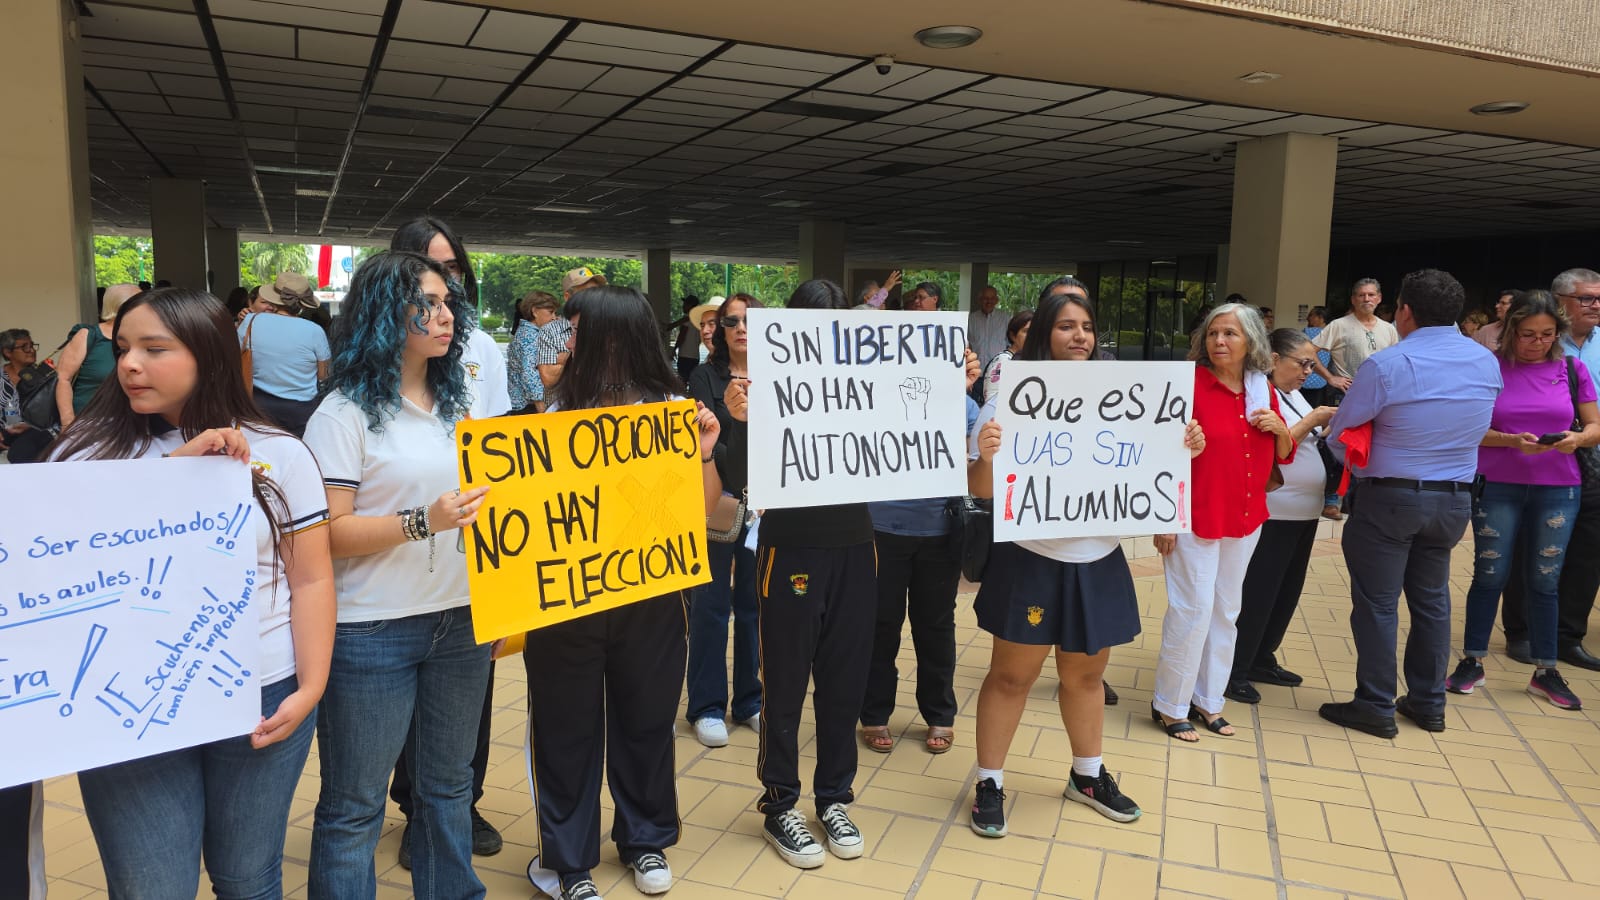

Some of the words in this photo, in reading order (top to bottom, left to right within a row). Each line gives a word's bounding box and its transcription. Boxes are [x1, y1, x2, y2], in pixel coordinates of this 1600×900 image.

[765, 321, 823, 366] SIN
[832, 320, 966, 368] LIBERTAD
[773, 375, 814, 418] NO
[822, 376, 874, 413] HAY
[1008, 376, 1083, 424] Que
[1154, 381, 1187, 425] La
[461, 427, 553, 484] ¡SIN
[568, 407, 698, 470] OPCIONES
[780, 427, 956, 488] AUTONOMIA
[1013, 431, 1074, 467] UAS
[1092, 430, 1144, 468] SIN
[471, 506, 531, 574] NO
[544, 485, 600, 552] HAY
[18, 592, 51, 609] los
[194, 568, 256, 653] importamos
